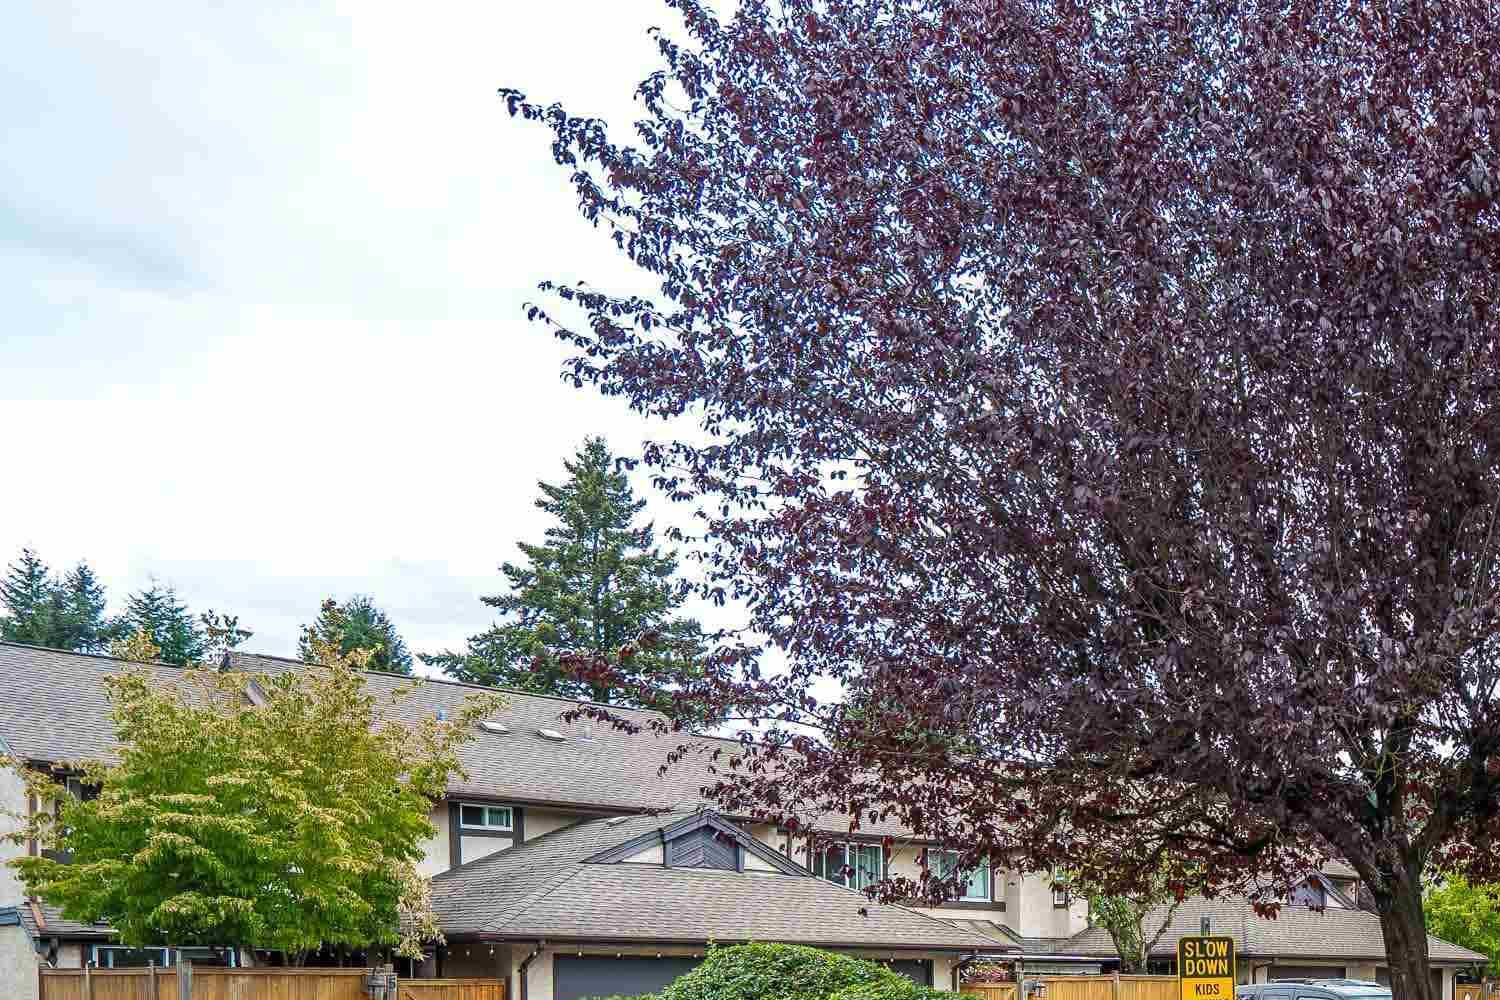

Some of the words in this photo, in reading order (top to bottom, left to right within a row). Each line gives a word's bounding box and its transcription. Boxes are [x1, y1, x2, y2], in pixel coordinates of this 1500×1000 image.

[1184, 941, 1228, 957] SLOW
[1185, 959, 1228, 975] DOWN
[1195, 983, 1220, 995] KIDS
